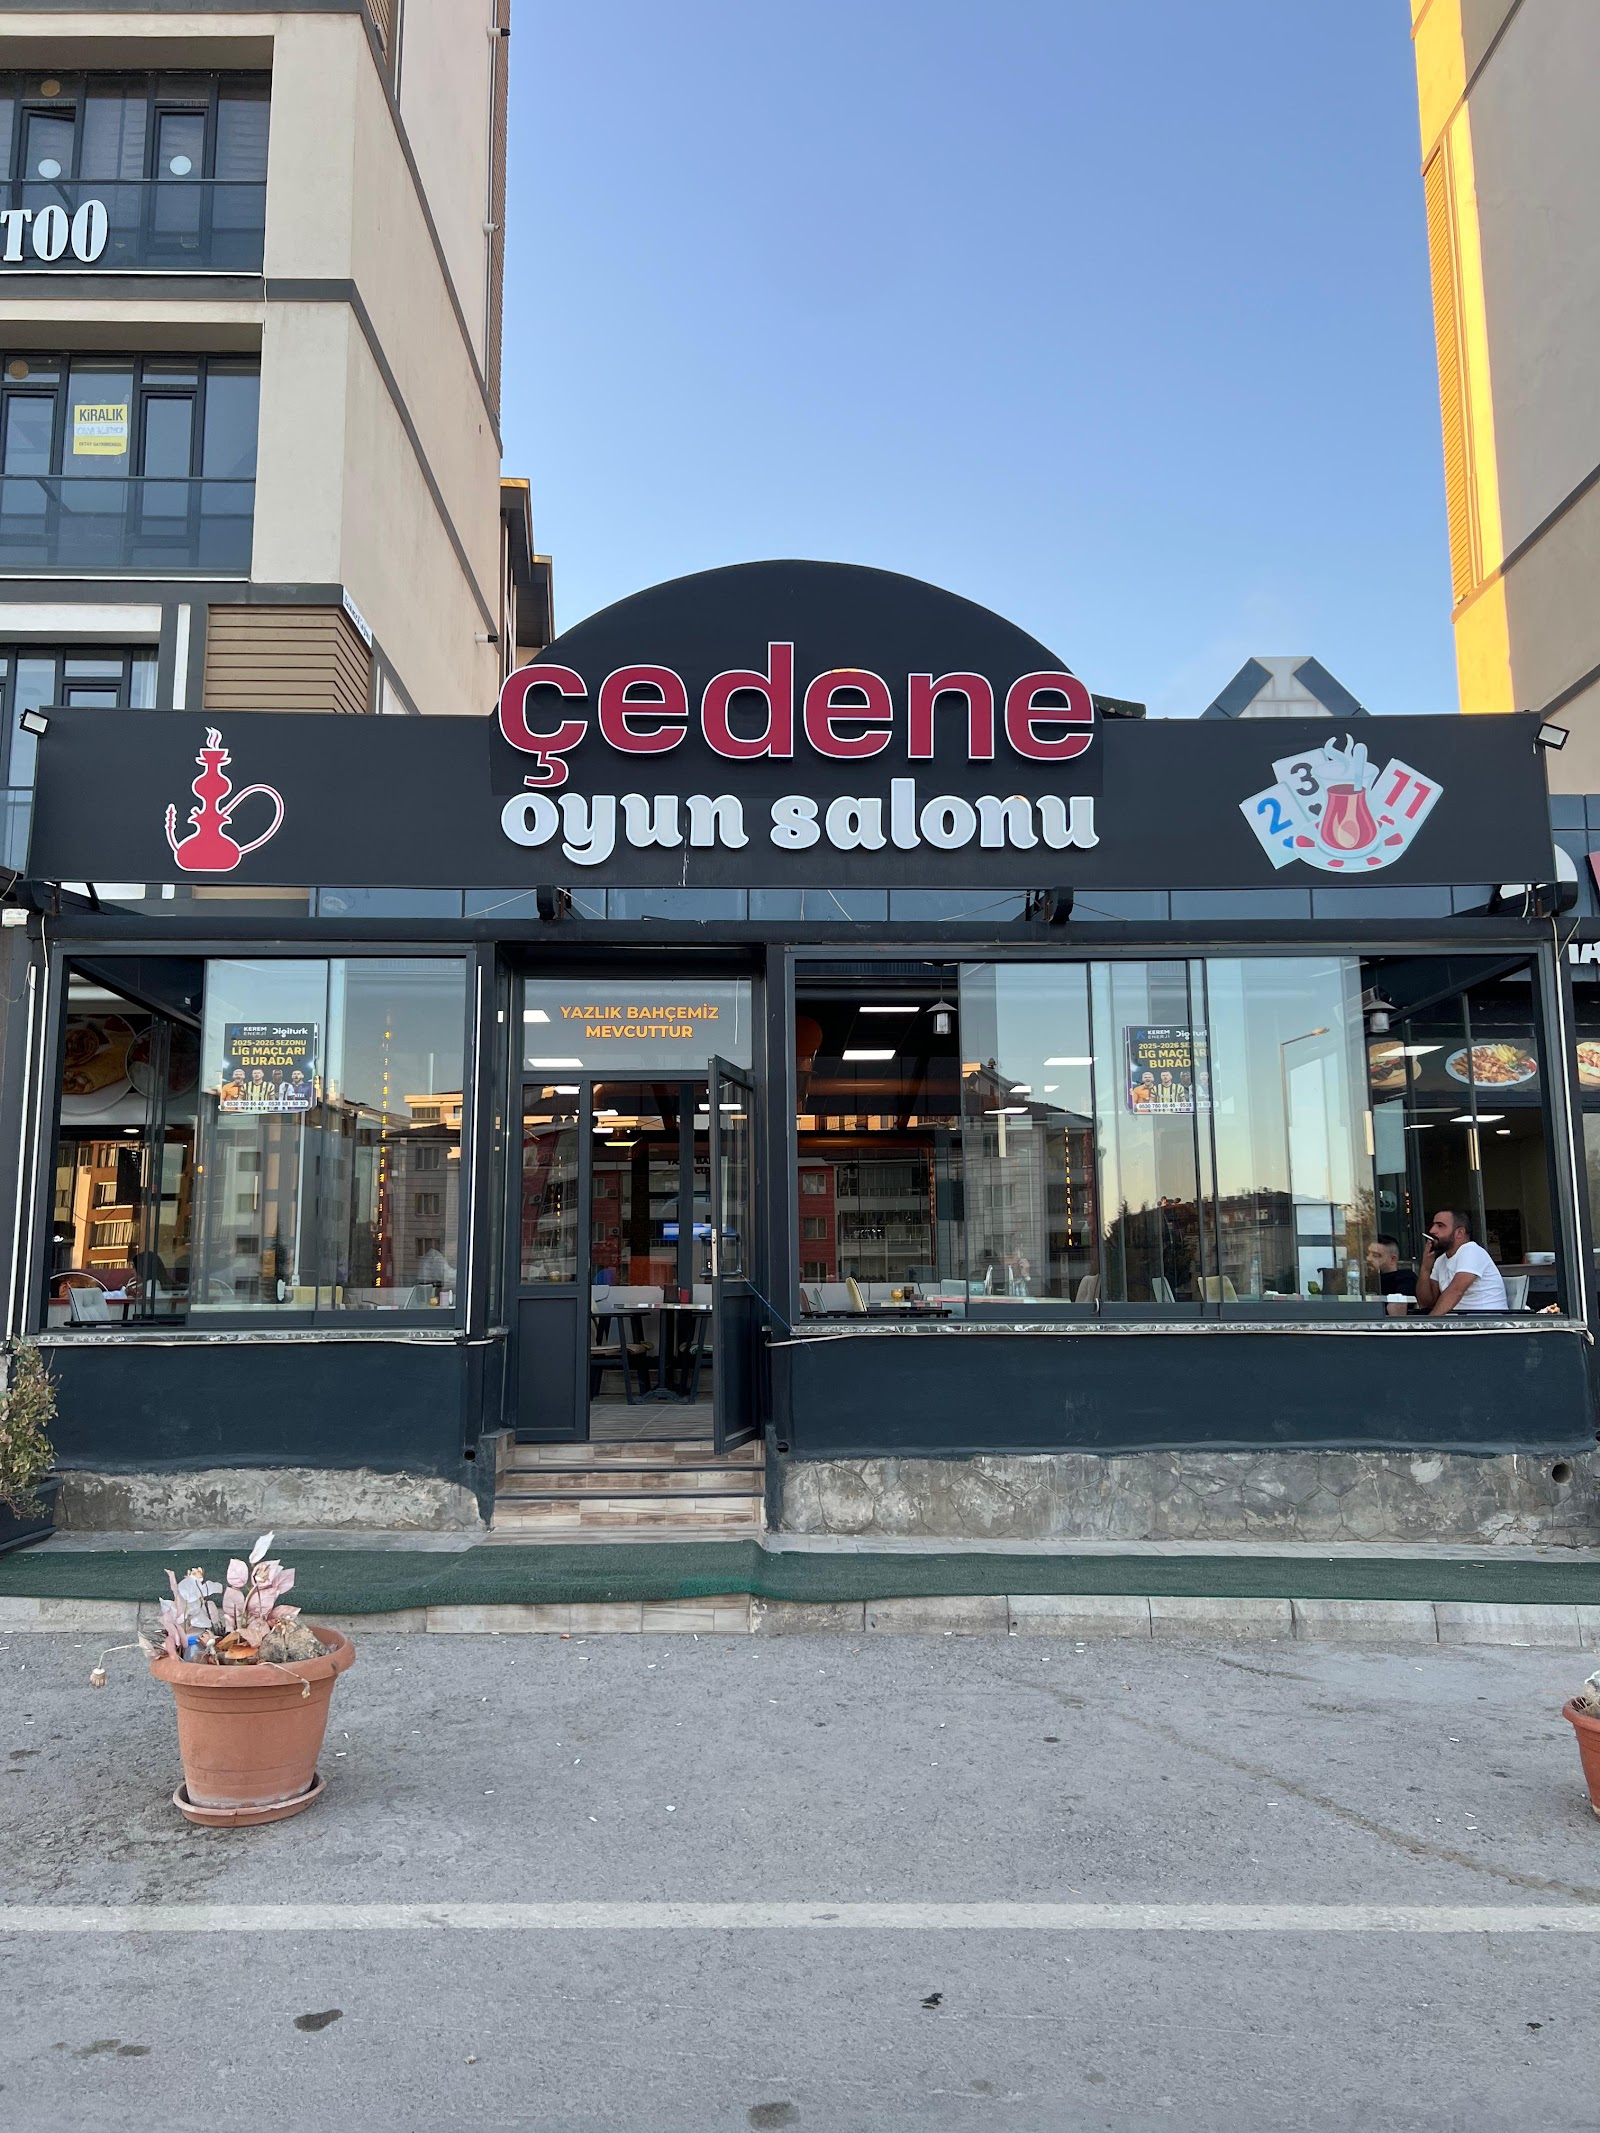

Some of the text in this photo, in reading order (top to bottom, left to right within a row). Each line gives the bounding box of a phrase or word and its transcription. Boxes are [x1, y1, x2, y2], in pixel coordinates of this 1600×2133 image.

[1, 200, 108, 262] TOO
[498, 641, 1095, 788] çedene
[1289, 762, 1320, 797] 3
[1384, 769, 1431, 820] 11
[501, 777, 1100, 866] oyun salonu
[1257, 797, 1293, 835] 2
[560, 1003, 720, 1022] YAZLIK BAHÇEMİZ
[272, 1027, 308, 1038] Digiturk
[585, 1025, 694, 1039] MEVCUTTUR
[241, 1056, 294, 1066] BURADA
[252, 1046, 306, 1058] MAÇLARI
[1158, 1048, 1208, 1060] MAÇLAR
